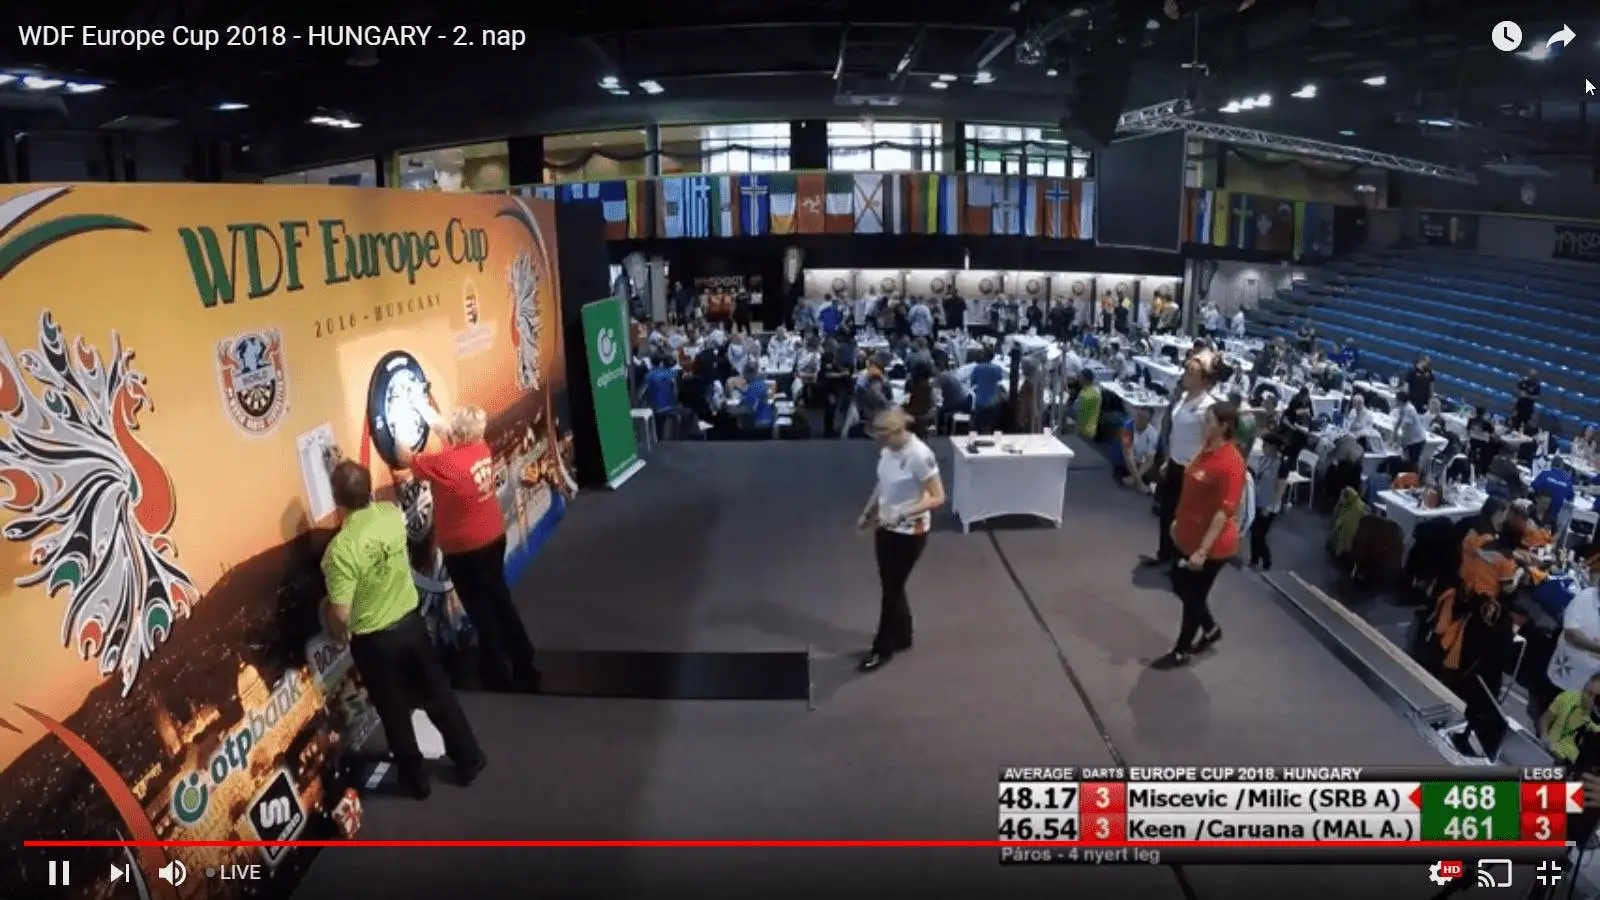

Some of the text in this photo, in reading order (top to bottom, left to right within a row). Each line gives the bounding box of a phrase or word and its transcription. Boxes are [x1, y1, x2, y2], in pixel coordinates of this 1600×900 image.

[178, 217, 489, 308] WDF Europe Cup
